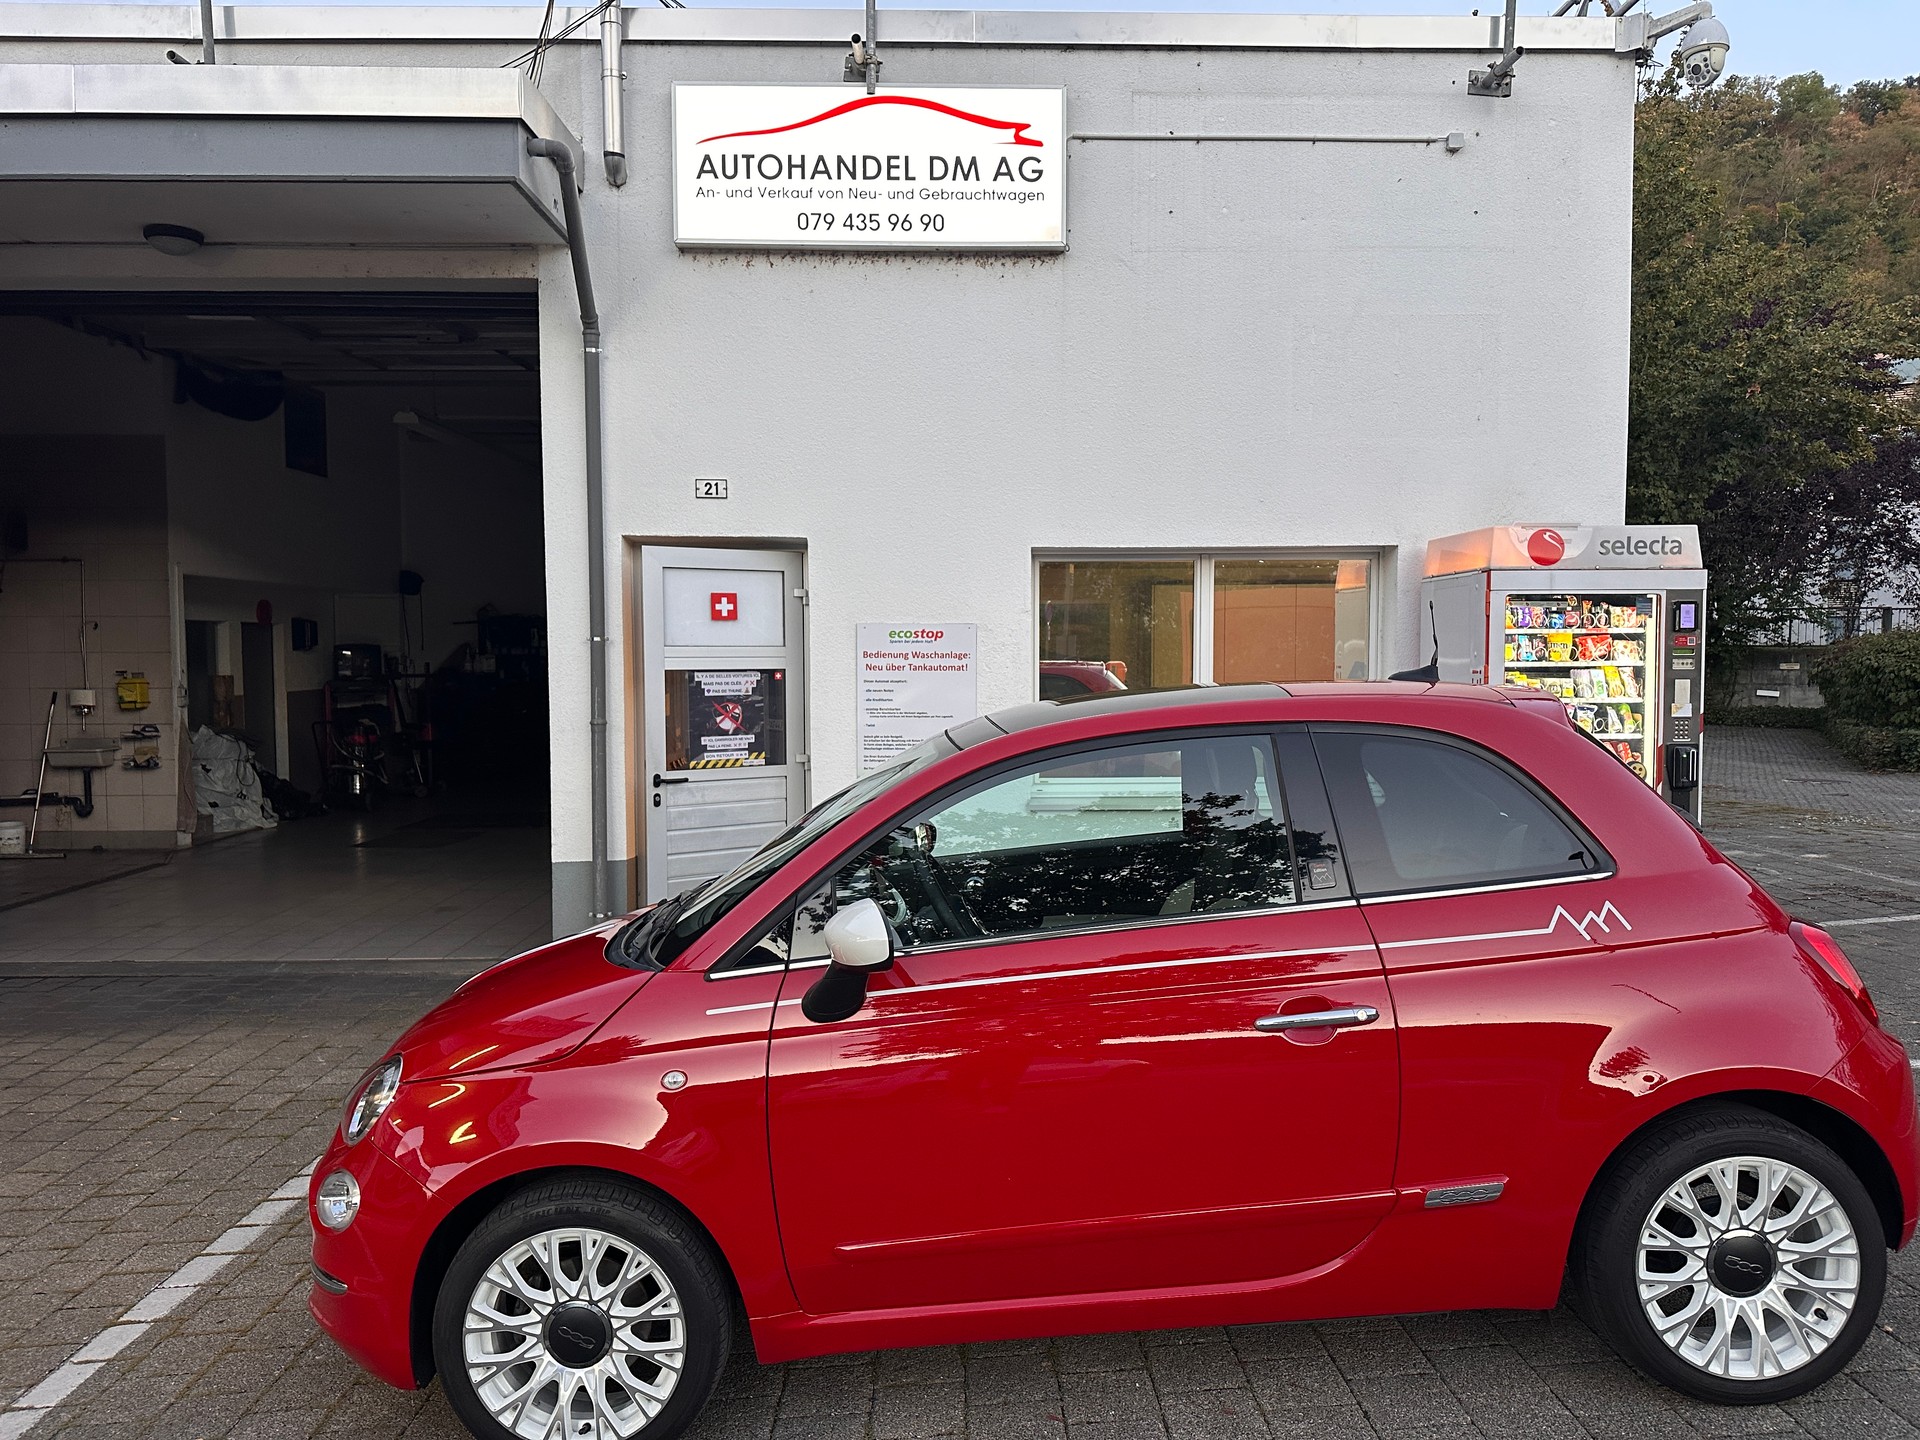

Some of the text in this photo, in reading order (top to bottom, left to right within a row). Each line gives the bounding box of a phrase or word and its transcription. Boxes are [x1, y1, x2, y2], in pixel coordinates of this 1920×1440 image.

[696, 154, 1044, 182] AUTOHANDEL DM AG
[695, 187, 1044, 204] An- und Verkauf von Neu- und Gebrauchtwagen
[797, 213, 944, 232] 079 435 96 90
[704, 482, 720, 496] 21
[1598, 536, 1682, 555] selecta
[889, 629, 944, 641] ecostop
[863, 651, 970, 660] Bedienung Waschanlage:
[886, 663, 906, 671] über
